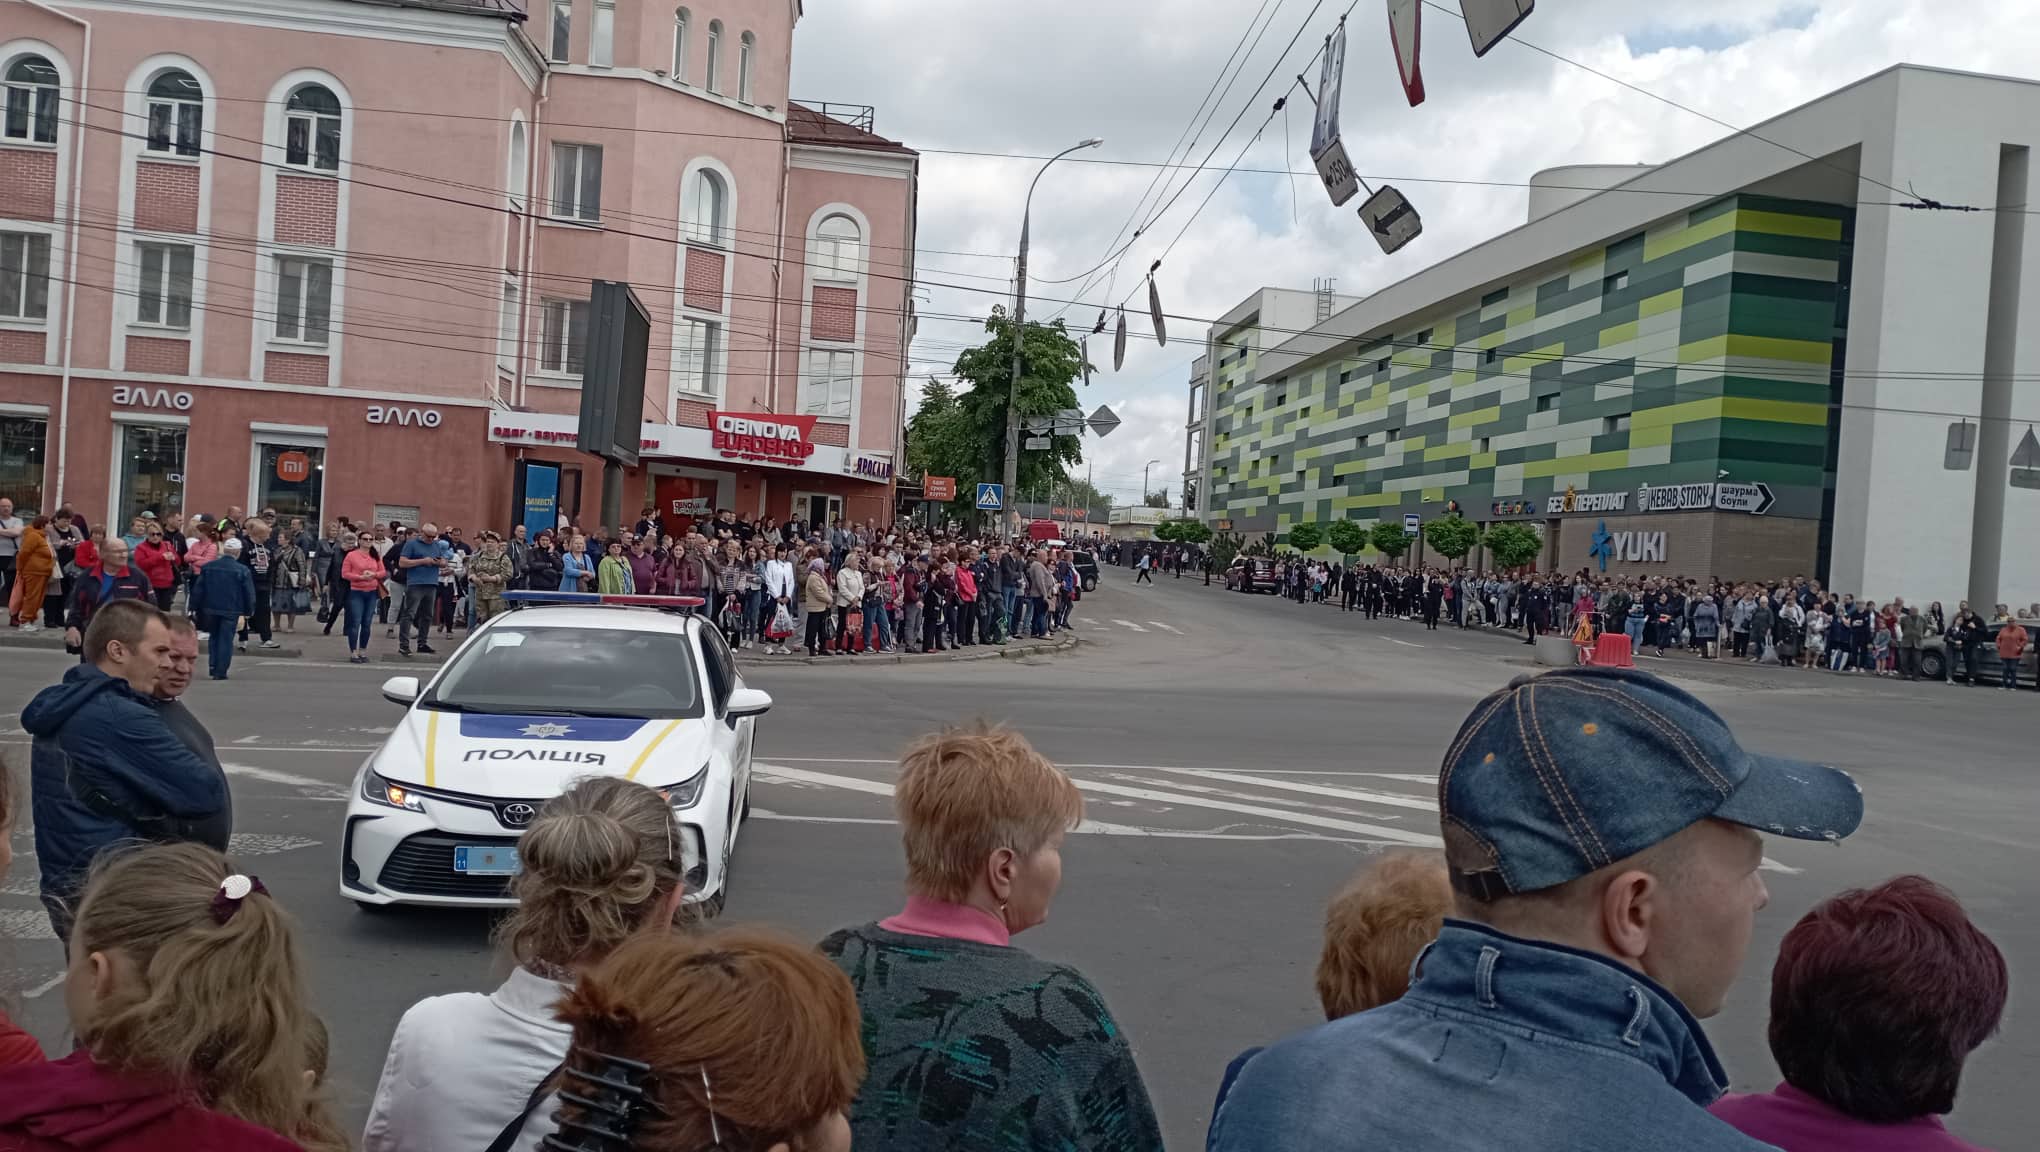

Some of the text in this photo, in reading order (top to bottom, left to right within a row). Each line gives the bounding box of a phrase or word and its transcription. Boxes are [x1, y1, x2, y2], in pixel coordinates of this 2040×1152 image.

[716, 415, 802, 442] OBNOVA
[712, 430, 815, 459] EUROSHOP
[1650, 484, 1710, 508] KEBAB STORY
[1720, 495, 1749, 508] боули
[1721, 487, 1758, 498] шаурма
[1613, 531, 1668, 563] YUKI
[463, 750, 606, 765] ПОЛІЦІЯ
